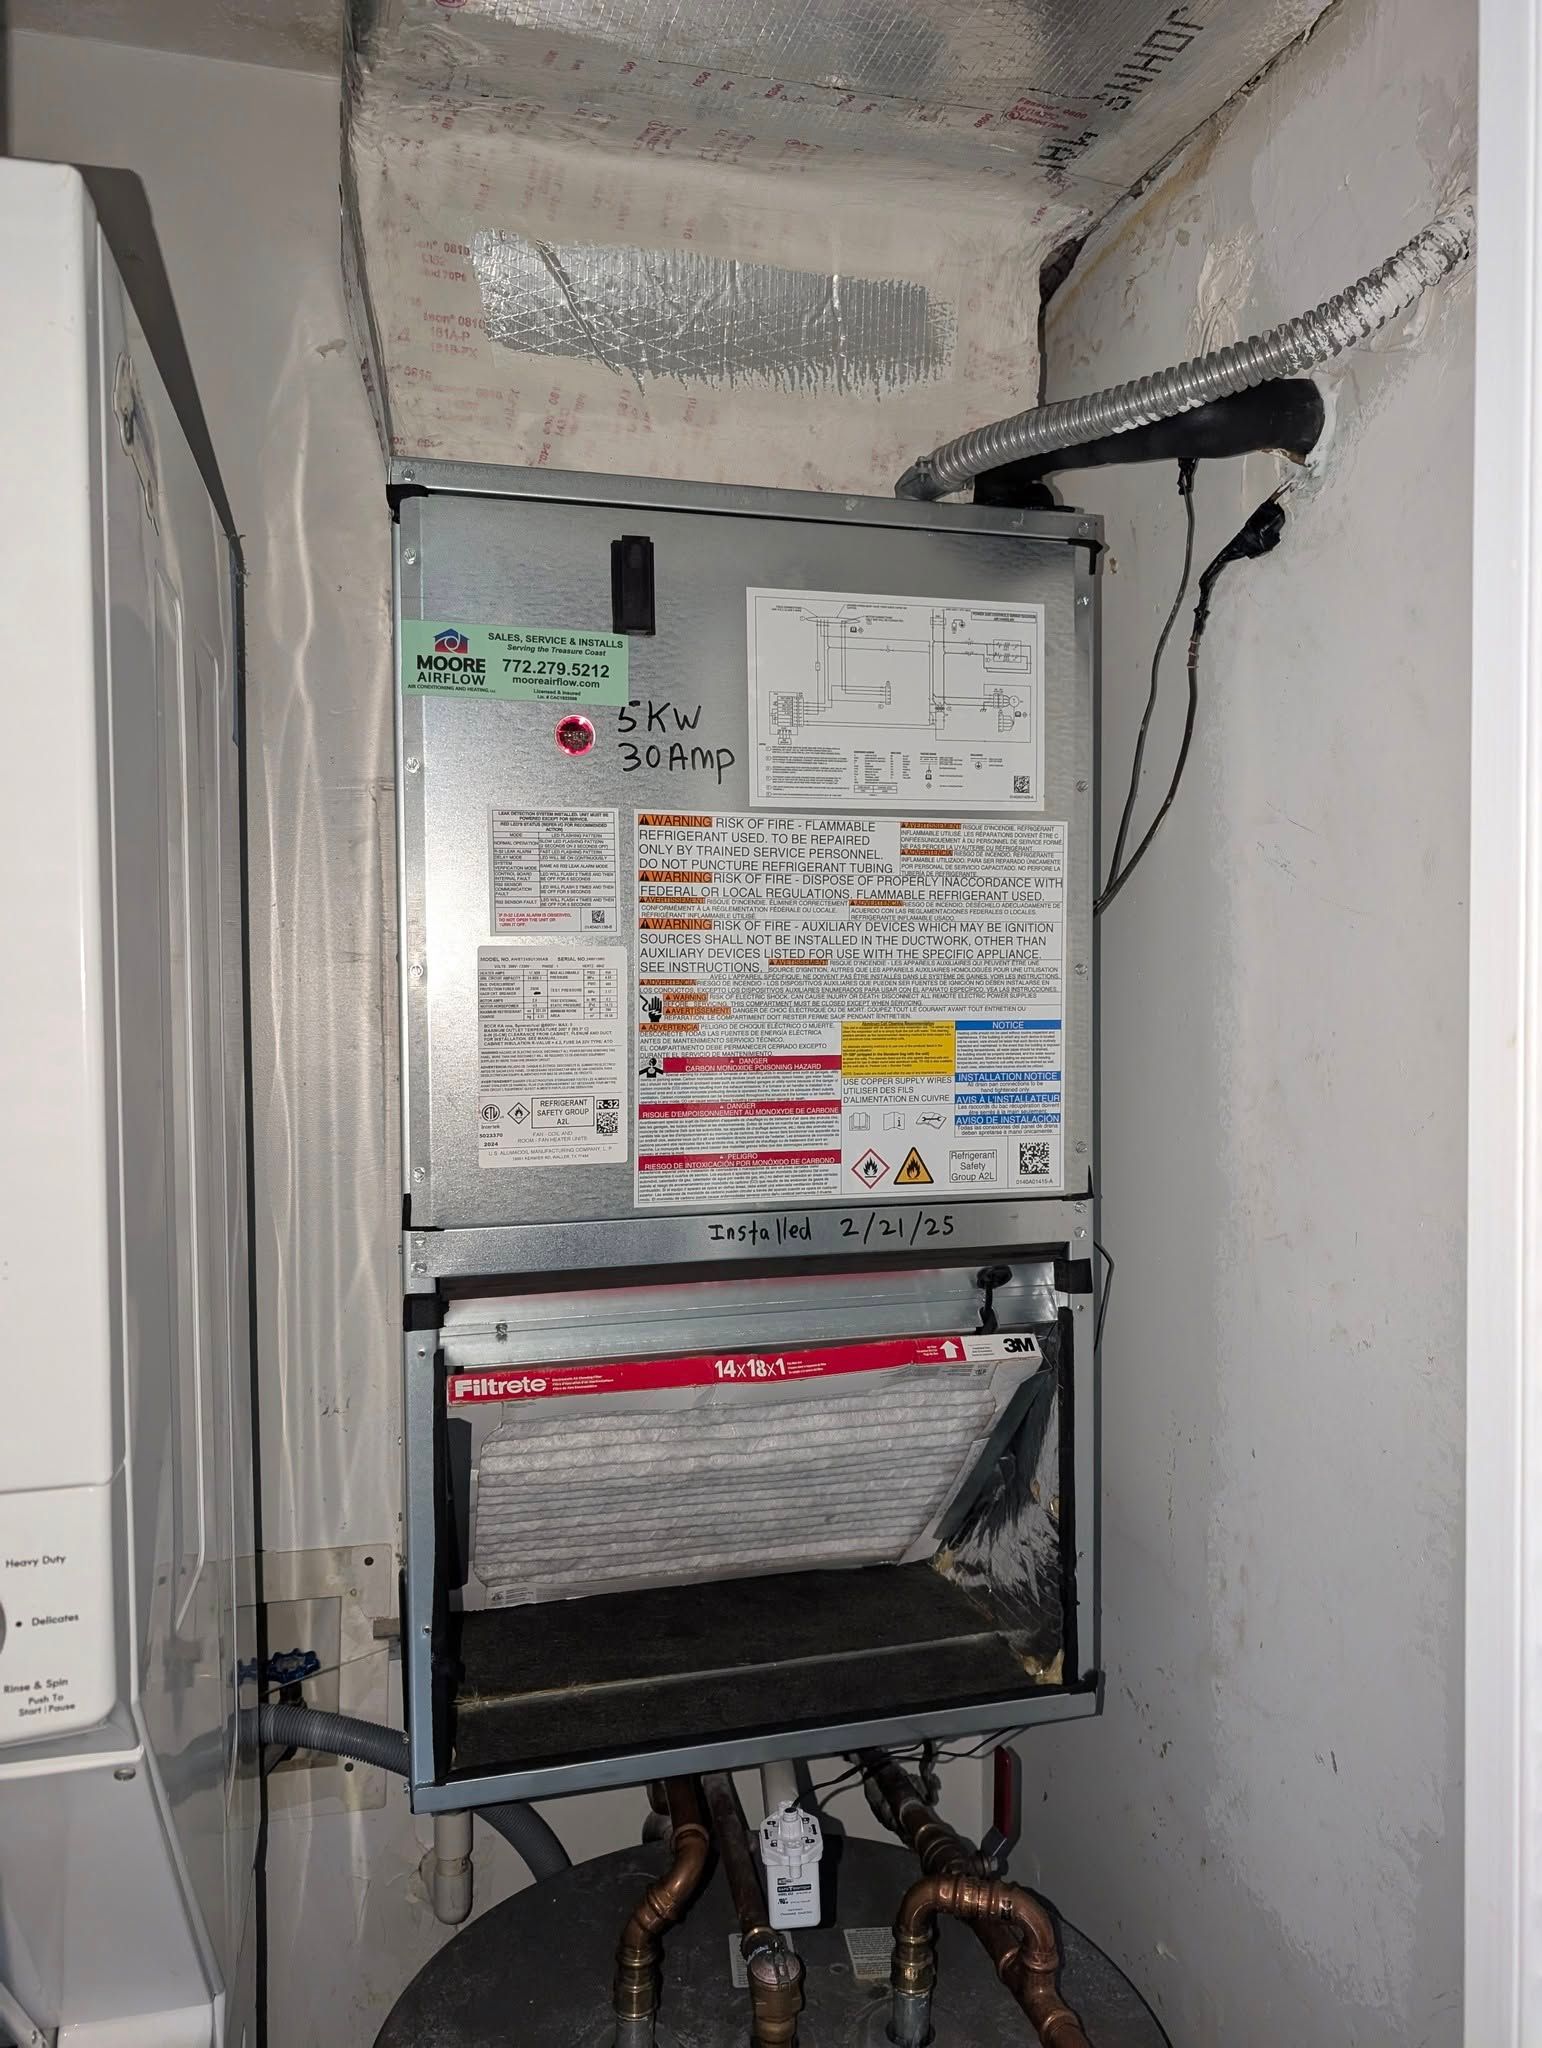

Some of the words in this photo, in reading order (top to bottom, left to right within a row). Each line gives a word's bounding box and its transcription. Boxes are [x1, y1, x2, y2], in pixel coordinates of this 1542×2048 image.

[488, 632, 523, 644] SALES,
[525, 635, 567, 645] SERVICE
[569, 637, 576, 646] &
[579, 638, 623, 649] INSTALLS
[507, 644, 535, 654] Serving
[551, 647, 582, 656] Treasure
[585, 649, 606, 657] Coast
[416, 655, 486, 674] MOORE
[502, 659, 610, 679] 772.279.5212
[417, 672, 486, 686] AIRFLOW
[512, 676, 600, 689] mooreairflow.com
[418, 684, 455, 692] CONDITIONING
[653, 815, 712, 827] WARNING
[716, 818, 744, 829] RISK
[748, 819, 764, 829] OF
[768, 819, 794, 830] FIRE
[805, 821, 875, 832] FLAMMABLE
[640, 830, 727, 842] REFRIGERANT
[732, 832, 768, 844] USED.
[771, 833, 788, 844] TO
[792, 834, 807, 844] BE
[811, 835, 870, 845] REPAIRED
[639, 844, 672, 855] ONLY
[677, 845, 693, 855] BY
[696, 846, 750, 856] TRAINED
[754, 847, 805, 858] SERVICE
[809, 848, 883, 860] PERSONNEL.
[639, 859, 658, 869] DO
[661, 859, 687, 869] NOT
[692, 860, 758, 871] PUNCTURE
[763, 861, 846, 872] REFRIGERANT
[850, 863, 893, 873] TUBING
[653, 871, 712, 883] WARNING
[714, 873, 742, 884] RISK
[745, 874, 762, 884] OF
[765, 874, 791, 884] FIRE
[802, 875, 854, 885] DISPOSE
[858, 876, 873, 886] OF
[877, 876, 938, 887] PROPERLY
[942, 877, 1031, 888] INACCORDANCE
[1034, 878, 1063, 888] WITH
[640, 886, 697, 896] FEDERAL
[701, 887, 719, 897] OR
[723, 888, 762, 898] LOCAL
[766, 888, 853, 899] REGULATIONS.
[857, 889, 925, 900] FLAMMABLE
[928, 890, 1008, 901] REFRIGERANT
[1011, 891, 1045, 901] USED.
[653, 919, 712, 929] WARNING
[714, 920, 741, 931] RISK
[745, 920, 761, 931] OF
[765, 921, 791, 931] FIRE
[802, 922, 861, 932] AUXILIARY
[865, 922, 915, 932] DEVICES
[919, 922, 956, 932] WHICH
[960, 922, 983, 932] MAY
[987, 923, 1001, 932] BE
[1005, 923, 1054, 933] IGNITION
[640, 934, 701, 944] SOURCES
[705, 934, 743, 945] SHALL
[747, 935, 772, 945] NOT
[775, 935, 790, 945] BE
[794, 935, 858, 945] INSTALLED
[861, 936, 872, 945] IN
[876, 936, 898, 946] THE
[901, 936, 971, 947] DUCTWORK,
[974, 936, 1013, 946] OTHER
[1017, 936, 1046, 946] THAN
[640, 948, 703, 958] AUXILIARY
[708, 948, 760, 958] DEVICES
[764, 949, 805, 959] LISTED
[809, 949, 833, 959] FOR
[837, 949, 860, 959] USE
[863, 949, 892, 959] WITH
[898, 949, 919, 959] THE
[922, 949, 973, 959] SPECIFIC
[977, 949, 1042, 959] APPLIANCE.
[640, 962, 665, 973] SEE
[669, 962, 763, 973] INSTRUCTIONS.
[992, 1021, 1024, 1029] NOTICE
[844, 1077, 858, 1085] USE
[860, 1077, 893, 1085] COPPER
[895, 1077, 924, 1085] SUPPLY
[958, 1072, 1022, 1081] INSTALLATION
[1024, 1072, 1057, 1081] NOTICE
[897, 1086, 913, 1094] FILS
[540, 1099, 587, 1107] REFRIGERANT
[597, 1100, 619, 1109] R-32
[844, 1094, 908, 1103] D'ALIMENTATION
[910, 1094, 921, 1102] EN
[922, 1094, 950, 1102] CUIVRE
[956, 1095, 979, 1104] AVIS
[988, 1094, 1059, 1103] L'INSTALLATEUR
[537, 1109, 562, 1117] SAFETY
[565, 1108, 589, 1116] GROUP
[671, 1109, 742, 1118] D'EMPOISONNEMENT
[956, 1115, 985, 1124] AVISO
[986, 1115, 999, 1124] DE
[1001, 1114, 1059, 1123] INSTALACIÓN
[951, 1151, 995, 1160] Refrigerant
[960, 1162, 986, 1171] Safety
[952, 1173, 976, 1181] Group
[978, 1172, 995, 1180] A2L
[708, 1216, 812, 1246] Installed
[840, 1211, 954, 1246] 2/21/25
[1003, 1337, 1035, 1353] 3M
[454, 1377, 547, 1398] Filtrete
[5, 1558, 38, 1569] Heavy
[42, 1555, 66, 1565] Duty
[32, 1613, 79, 1627] Delicates
[4, 1685, 30, 1693] Rinse
[34, 1681, 42, 1689] &
[46, 1678, 68, 1689] Spin
[28, 1696, 49, 1705] Push
[52, 1694, 64, 1702] To
[18, 1706, 42, 1717] Start
[48, 1703, 75, 1713] Pause
